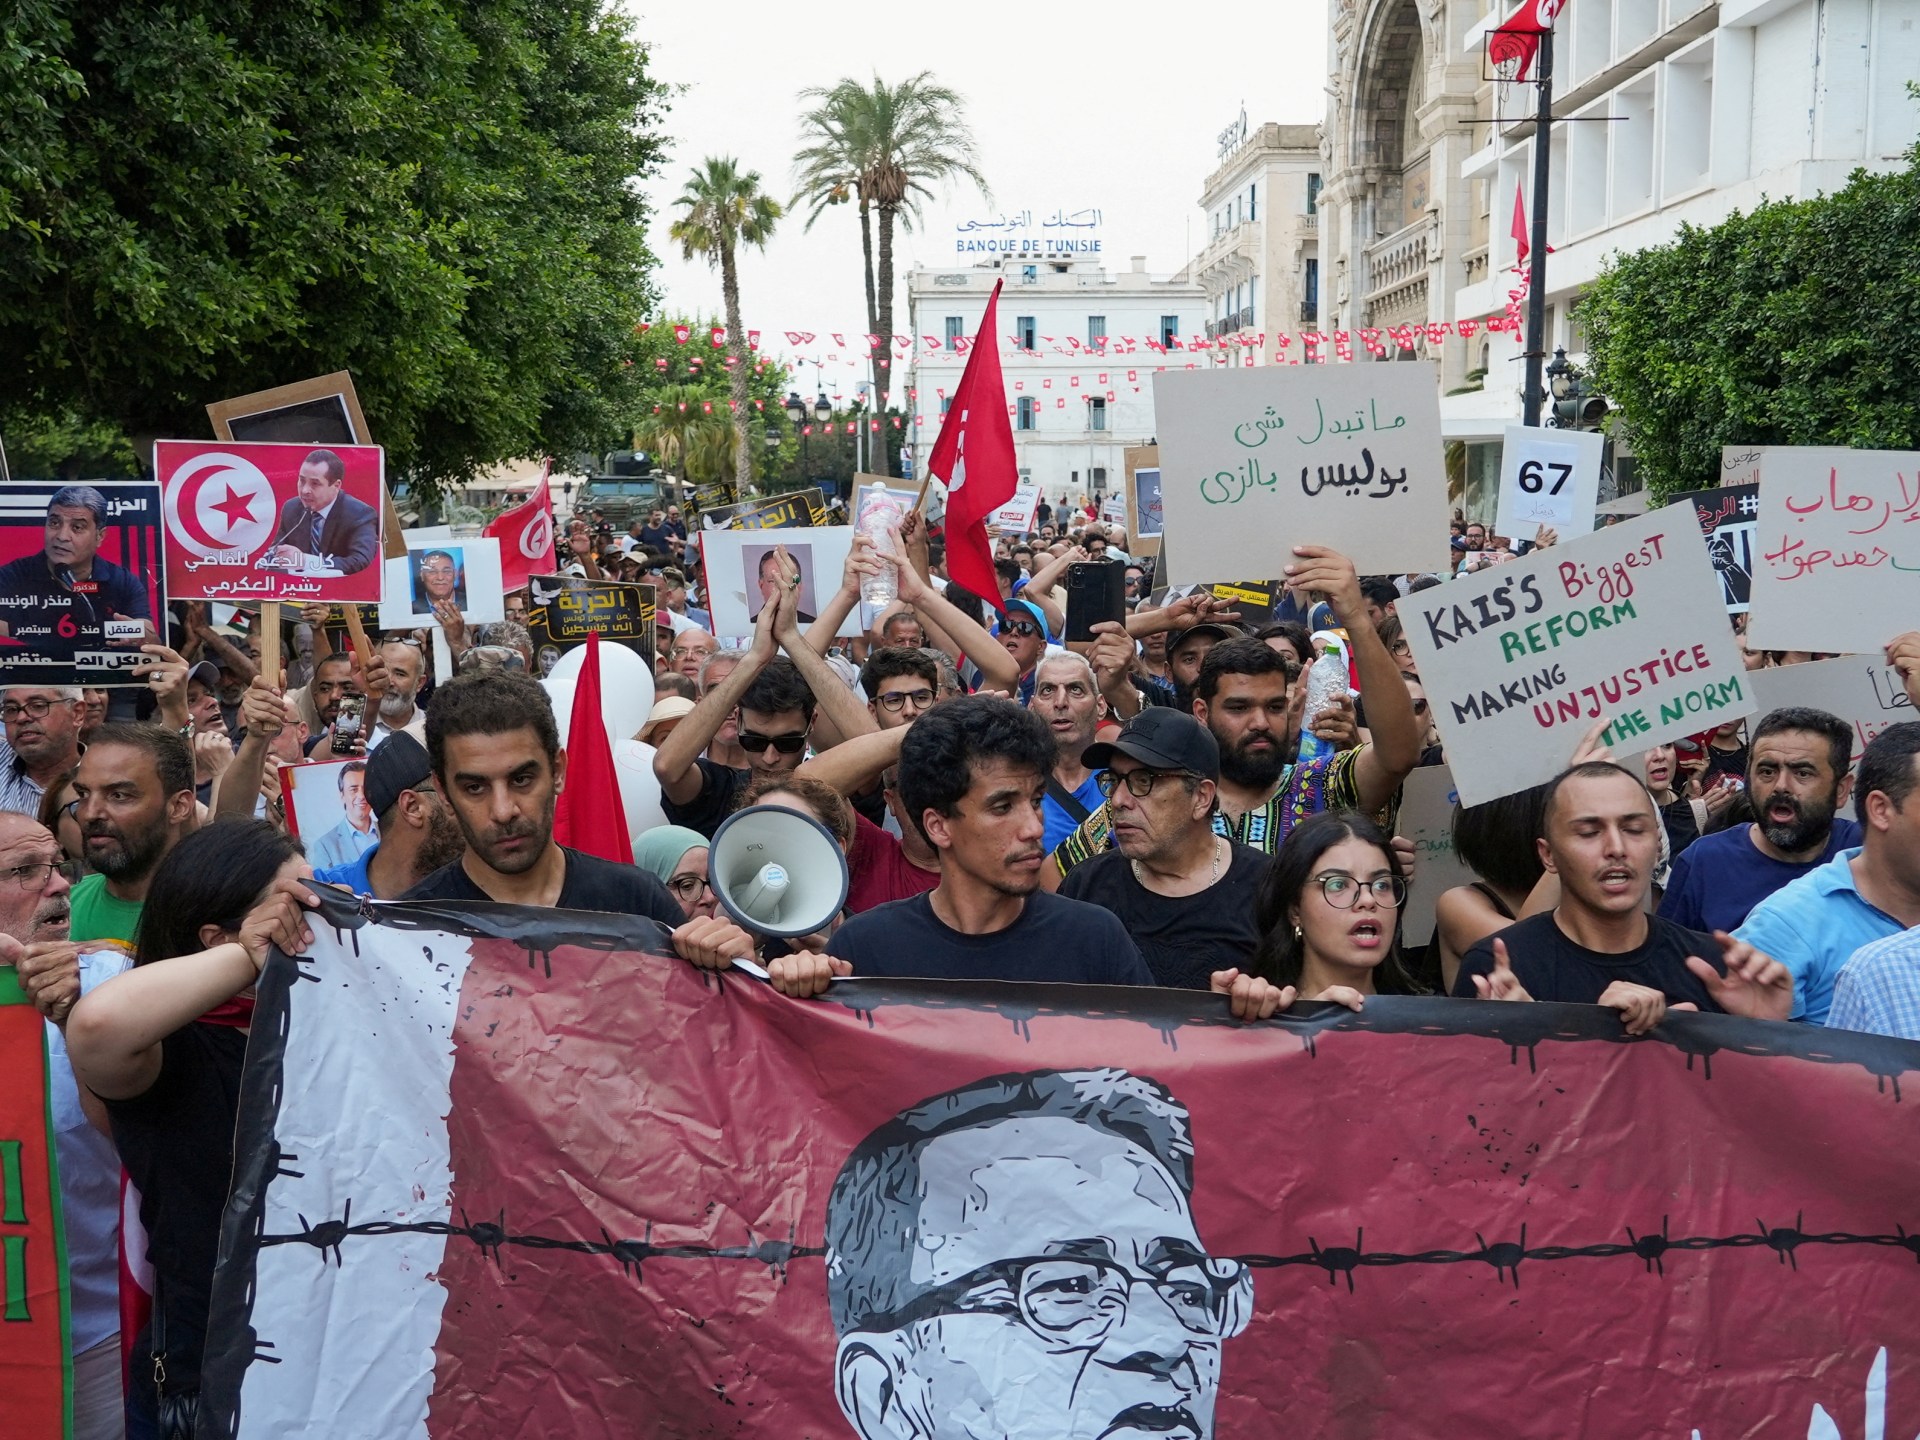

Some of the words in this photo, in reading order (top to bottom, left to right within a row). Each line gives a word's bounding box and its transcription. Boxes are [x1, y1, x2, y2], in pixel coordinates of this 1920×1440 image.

[1043, 209, 1102, 229] البنك
[957, 240, 1016, 252] BANQUE
[1022, 240, 1039, 252] DE
[1046, 240, 1101, 252] TUNISIE
[1302, 448, 1408, 498] بوليس
[1518, 460, 1573, 496] 67
[184, 551, 248, 571] للقاضي
[254, 551, 303, 571] الدعم
[310, 553, 335, 570] كل
[203, 576, 275, 597] العكرمي
[280, 576, 322, 597] بشير
[42, 595, 71, 609] منذر
[559, 591, 625, 613] الحرية
[1423, 574, 1543, 650] KAIS'S
[15, 625, 51, 636] سبتمبر
[57, 613, 77, 638] 6
[81, 624, 100, 635] منذ
[107, 624, 142, 636] معتقل
[562, 622, 608, 636] فلسطين
[612, 622, 634, 634] إلى
[1500, 599, 1637, 663] REFORM
[1450, 663, 1566, 725] MAKING
[1600, 708, 1652, 747] THE
[1660, 675, 1743, 726] NORM
